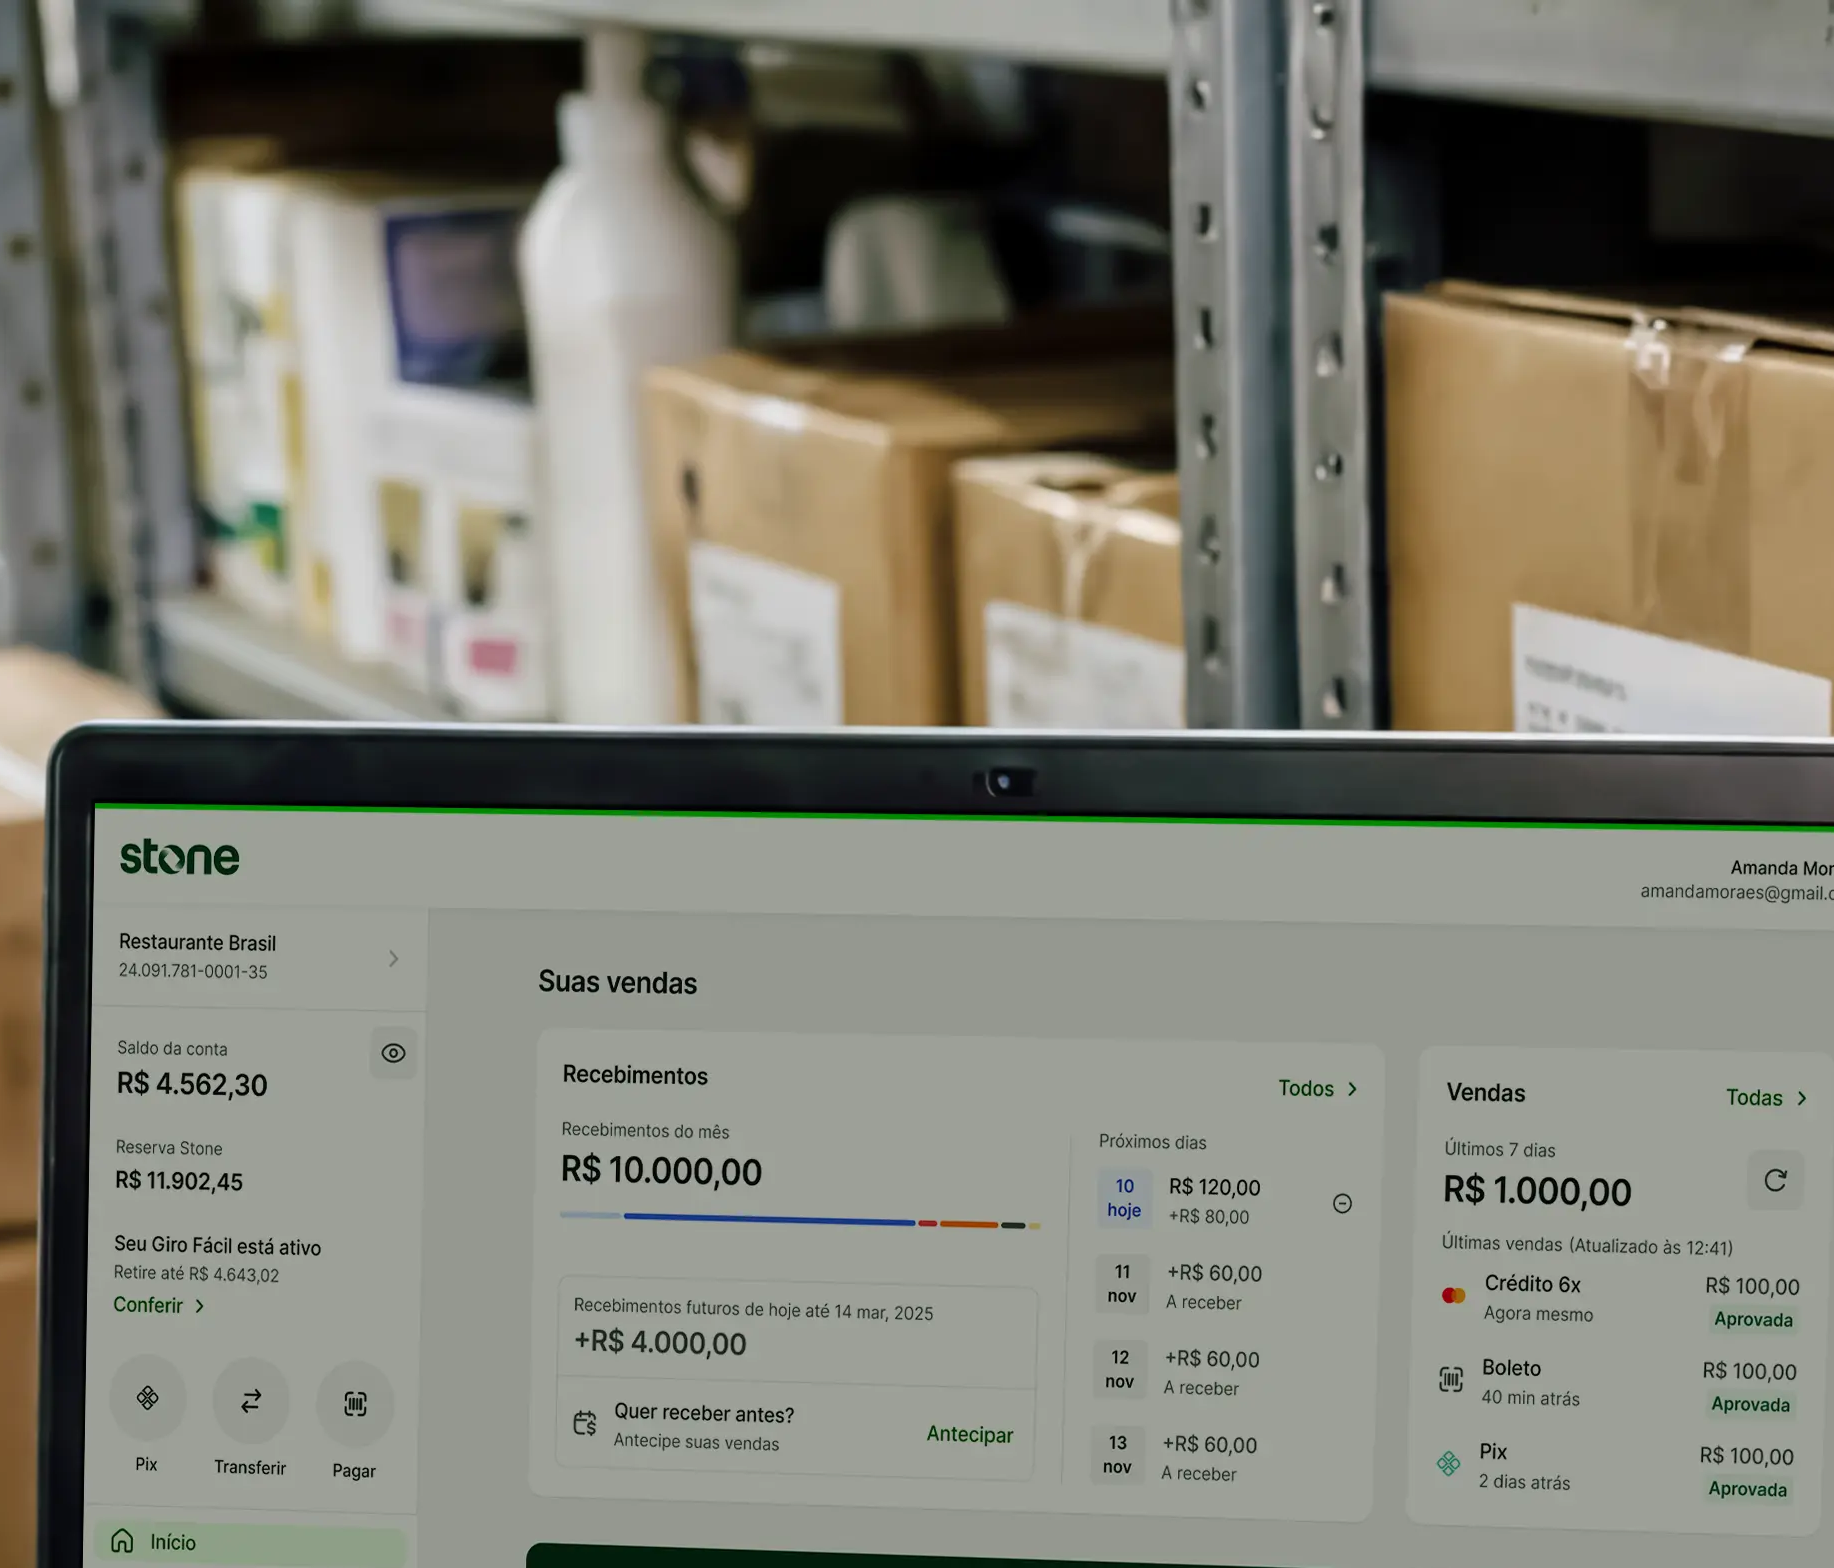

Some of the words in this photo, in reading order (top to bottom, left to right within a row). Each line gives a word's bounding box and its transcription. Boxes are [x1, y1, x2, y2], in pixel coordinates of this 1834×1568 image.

[120, 838, 239, 876] stone
[1731, 860, 1797, 875] Amanda
[120, 933, 223, 951] Restaurante
[230, 934, 275, 952] Brasil
[120, 962, 267, 980] 24.091.781-0001-35
[539, 969, 599, 993] Suas
[607, 971, 697, 995] vendas
[118, 1040, 158, 1055] Saldo
[164, 1042, 181, 1056] da
[187, 1043, 227, 1057] conta
[564, 1064, 708, 1085] Recebimentos
[118, 1069, 149, 1097] R$
[157, 1071, 267, 1101] 4.562,30
[1279, 1079, 1334, 1098] Todos
[1447, 1082, 1525, 1103] Vendas
[1727, 1088, 1782, 1107] Todas
[563, 1122, 669, 1138] Recebimentos
[675, 1124, 693, 1139] do
[699, 1124, 729, 1140] mês
[117, 1139, 175, 1155] Reserva
[181, 1140, 222, 1156] Stone
[1100, 1132, 1170, 1150] Próximos
[1175, 1134, 1206, 1151] dias
[1446, 1137, 1503, 1157] Últimos
[1510, 1142, 1518, 1157] 7
[1524, 1142, 1555, 1158] dias
[563, 1151, 601, 1185] R$
[610, 1155, 761, 1192] 10.000,00
[117, 1168, 141, 1191] R$
[148, 1170, 242, 1195] 11.902,45
[1117, 1179, 1134, 1194] 10
[1170, 1177, 1193, 1196] R$
[1200, 1178, 1260, 1200] 120,00
[1445, 1171, 1484, 1206] R$
[1495, 1175, 1631, 1212] 1.000,00
[1108, 1202, 1141, 1221] hoje
[1170, 1207, 1199, 1224] +R$
[1206, 1208, 1249, 1227] 80,00
[115, 1235, 146, 1252] Seu
[152, 1236, 187, 1253] Giro
[194, 1236, 231, 1254] Fácil
[238, 1237, 273, 1255] está
[280, 1239, 321, 1256] ativo
[1443, 1230, 1500, 1251] Últimas
[1506, 1237, 1562, 1252] vendas
[1570, 1236, 1657, 1254] (Atualizado
[1664, 1239, 1680, 1255] às
[1688, 1240, 1732, 1257] 12:41)
[115, 1264, 156, 1280] Retire
[161, 1265, 184, 1280] até
[190, 1266, 208, 1282] R$
[214, 1267, 279, 1285] 4.643,02
[1116, 1264, 1129, 1279] 11
[1169, 1262, 1203, 1282] +R$
[1210, 1264, 1262, 1285] 60,00
[1486, 1273, 1553, 1292] Crédito
[1559, 1275, 1580, 1293] 6x
[1707, 1275, 1729, 1295] R$
[1737, 1277, 1799, 1298] 100,00
[114, 1296, 183, 1314] Conferir
[575, 1297, 681, 1314] Recebimentos
[687, 1299, 739, 1316] futuros
[745, 1302, 763, 1316] de
[769, 1302, 800, 1321] hoje
[806, 1303, 829, 1319] até
[836, 1304, 851, 1318] 14
[857, 1308, 888, 1322] mar,
[895, 1305, 933, 1321] 2025
[1484, 1305, 1530, 1324] Agora
[1537, 1309, 1593, 1322] mesmo
[1715, 1311, 1792, 1330] Aprovada
[576, 1327, 623, 1355] +R$
[632, 1330, 746, 1360] 4.000,00
[1112, 1350, 1129, 1365] 12
[1166, 1348, 1201, 1368] +R$
[1207, 1350, 1259, 1371] 60,00
[1483, 1359, 1541, 1377] Boleto
[1482, 1389, 1502, 1404] 40
[1508, 1390, 1534, 1405] min
[1541, 1391, 1580, 1407] atrás
[1712, 1396, 1790, 1414] Aprovada
[615, 1402, 657, 1420] Quer
[663, 1404, 731, 1422] receber
[736, 1406, 794, 1424] antes?
[614, 1432, 680, 1451] Antecipe
[686, 1438, 719, 1449] suas
[725, 1437, 779, 1451] vendas
[927, 1425, 1013, 1447] Antecipar
[1110, 1435, 1126, 1450] 13
[1164, 1433, 1198, 1453] +R$
[1205, 1436, 1257, 1456] 60,00
[1481, 1442, 1507, 1460] Pix
[136, 1456, 157, 1471] Pix
[215, 1459, 286, 1476] Transferir
[334, 1463, 376, 1481] Pagar
[1480, 1473, 1488, 1488] 2
[1494, 1473, 1525, 1490] dias
[1531, 1475, 1570, 1491] atrás
[1709, 1481, 1787, 1499] Aprovada
[152, 1532, 196, 1551] Início
